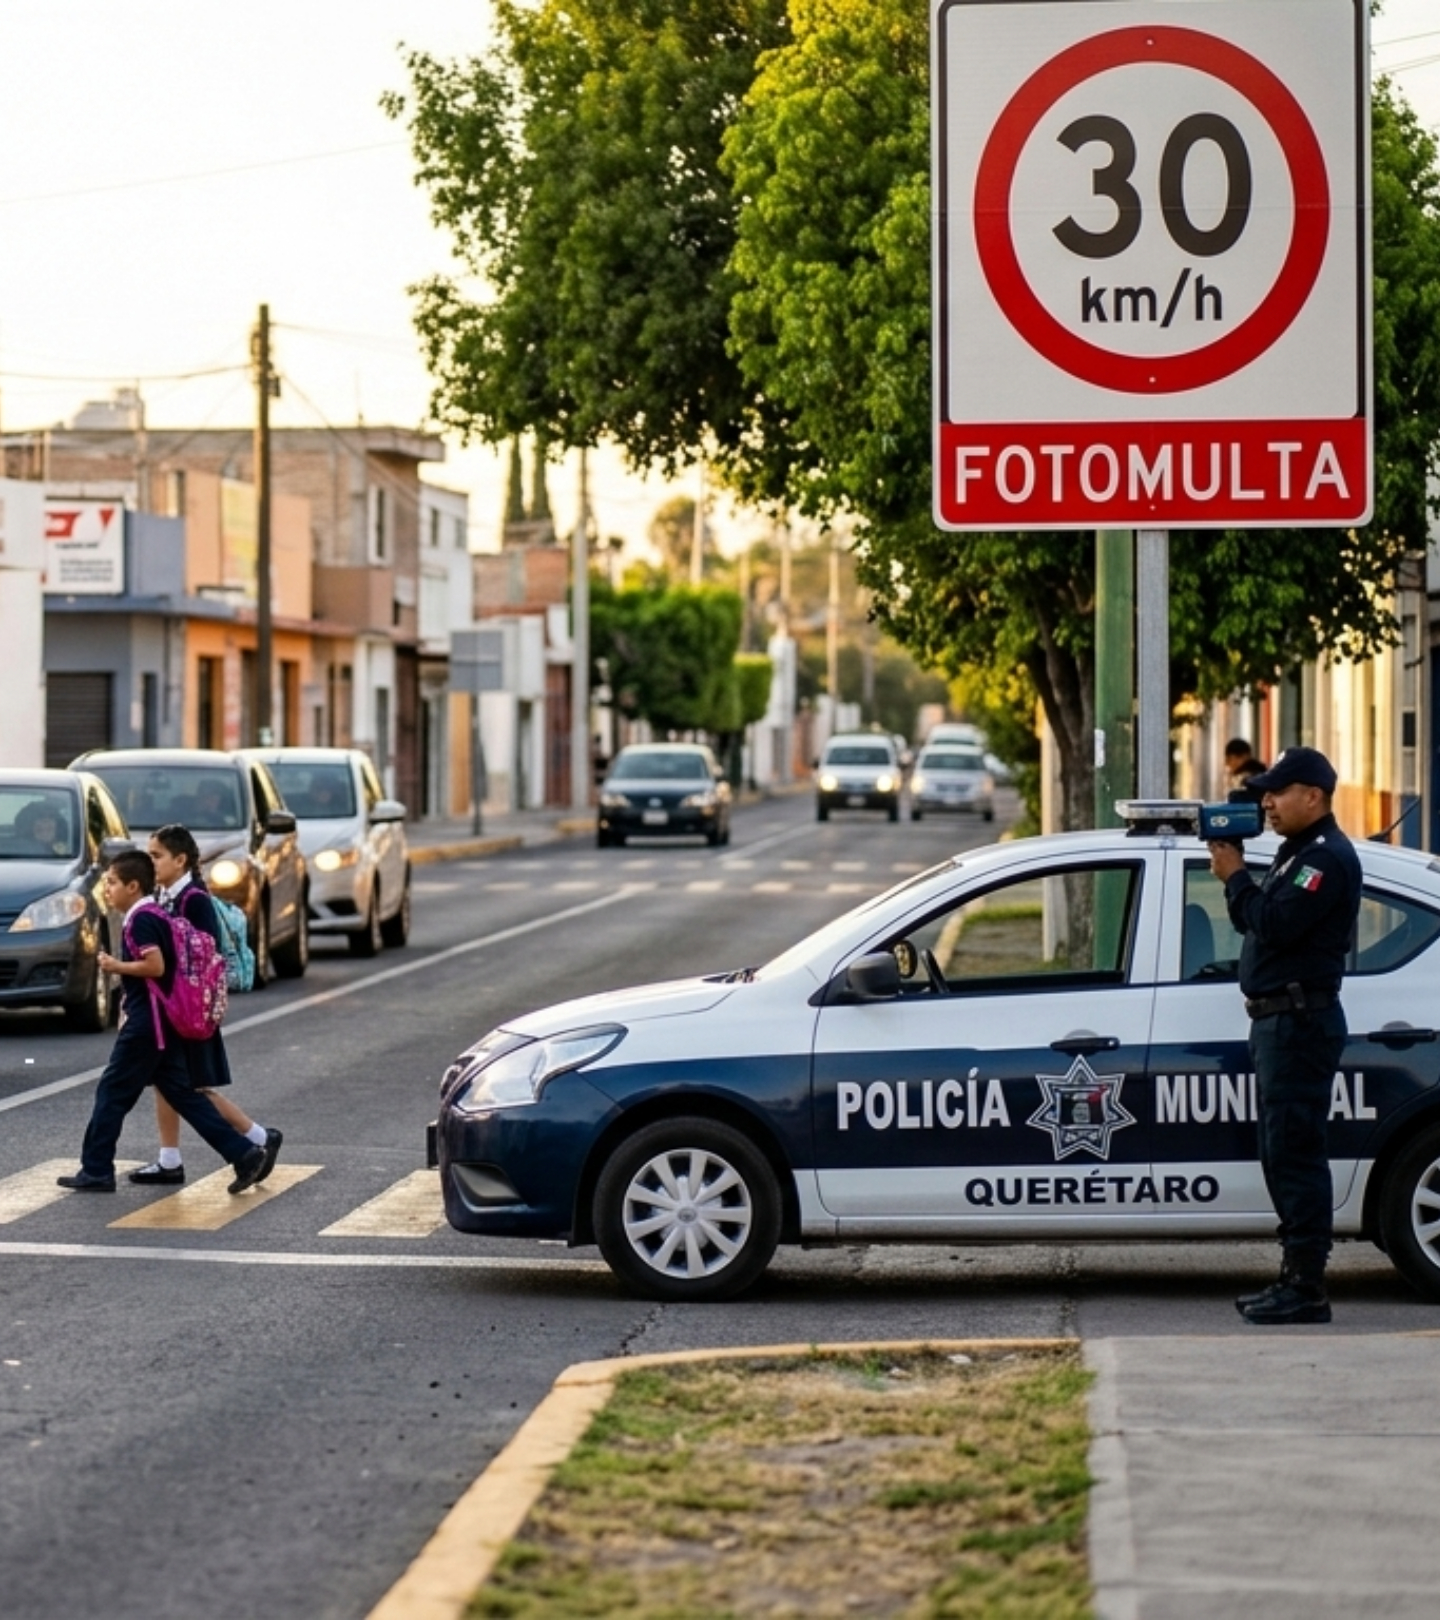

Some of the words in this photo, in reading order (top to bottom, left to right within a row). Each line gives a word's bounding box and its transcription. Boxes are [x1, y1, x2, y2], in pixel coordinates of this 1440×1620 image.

[1052, 112, 1253, 260] 30
[1081, 267, 1223, 328] km/h
[954, 441, 1351, 504] FOTOMULTA
[837, 1067, 1011, 1131] POLICÍA
[1156, 1071, 1377, 1124] MUNIAL
[964, 1169, 1220, 1206] QUERÉTARO
